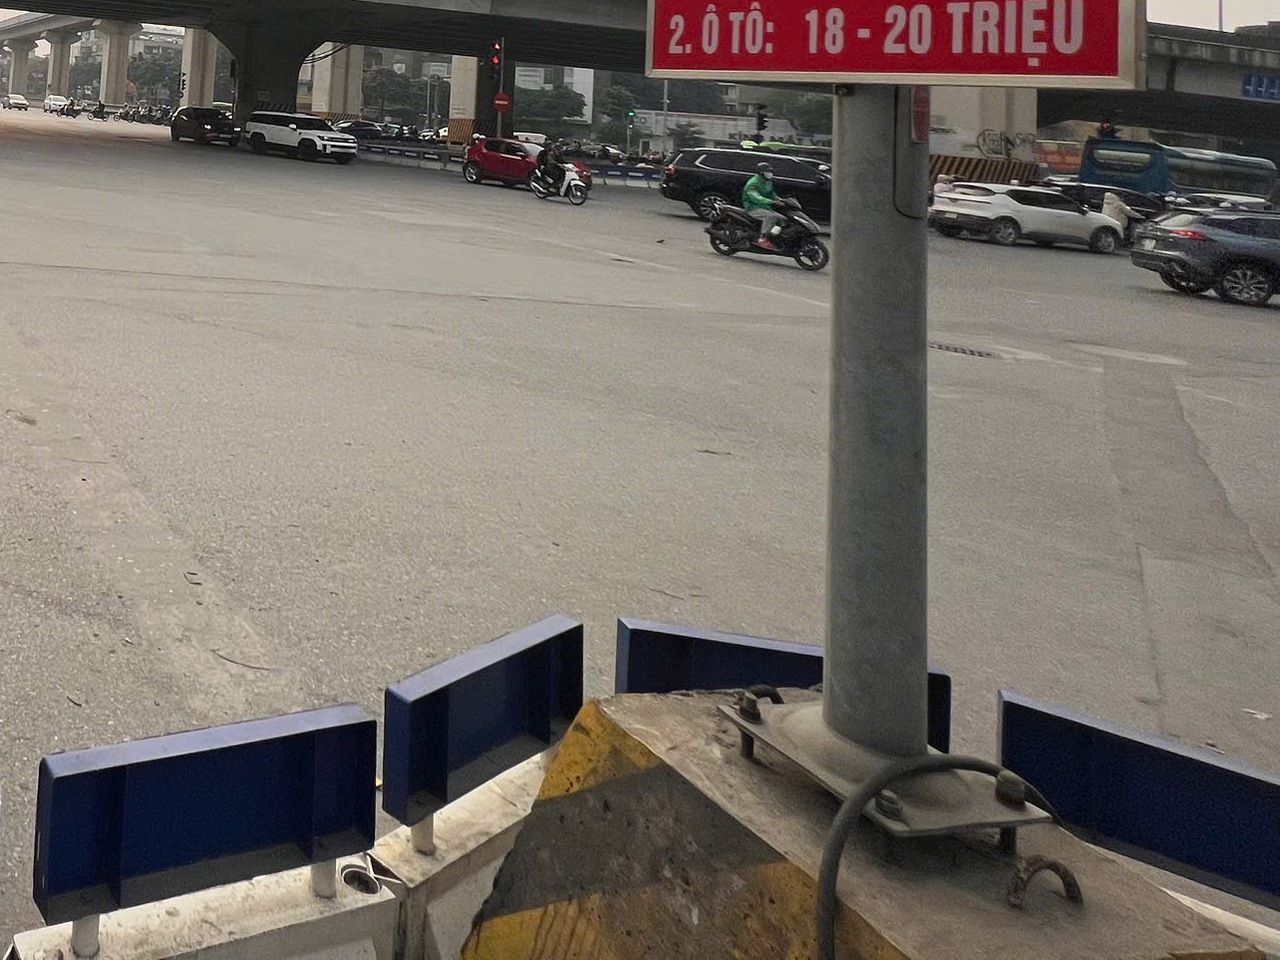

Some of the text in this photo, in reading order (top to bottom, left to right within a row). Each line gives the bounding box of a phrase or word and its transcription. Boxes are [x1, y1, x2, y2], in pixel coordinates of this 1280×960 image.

[668, 14, 692, 54] 2.
[702, 3, 719, 54] Ô
[728, 1, 774, 54] TÔ:
[805, 6, 844, 54] 18
[857, 28, 870, 39] -
[883, 3, 933, 55] 20
